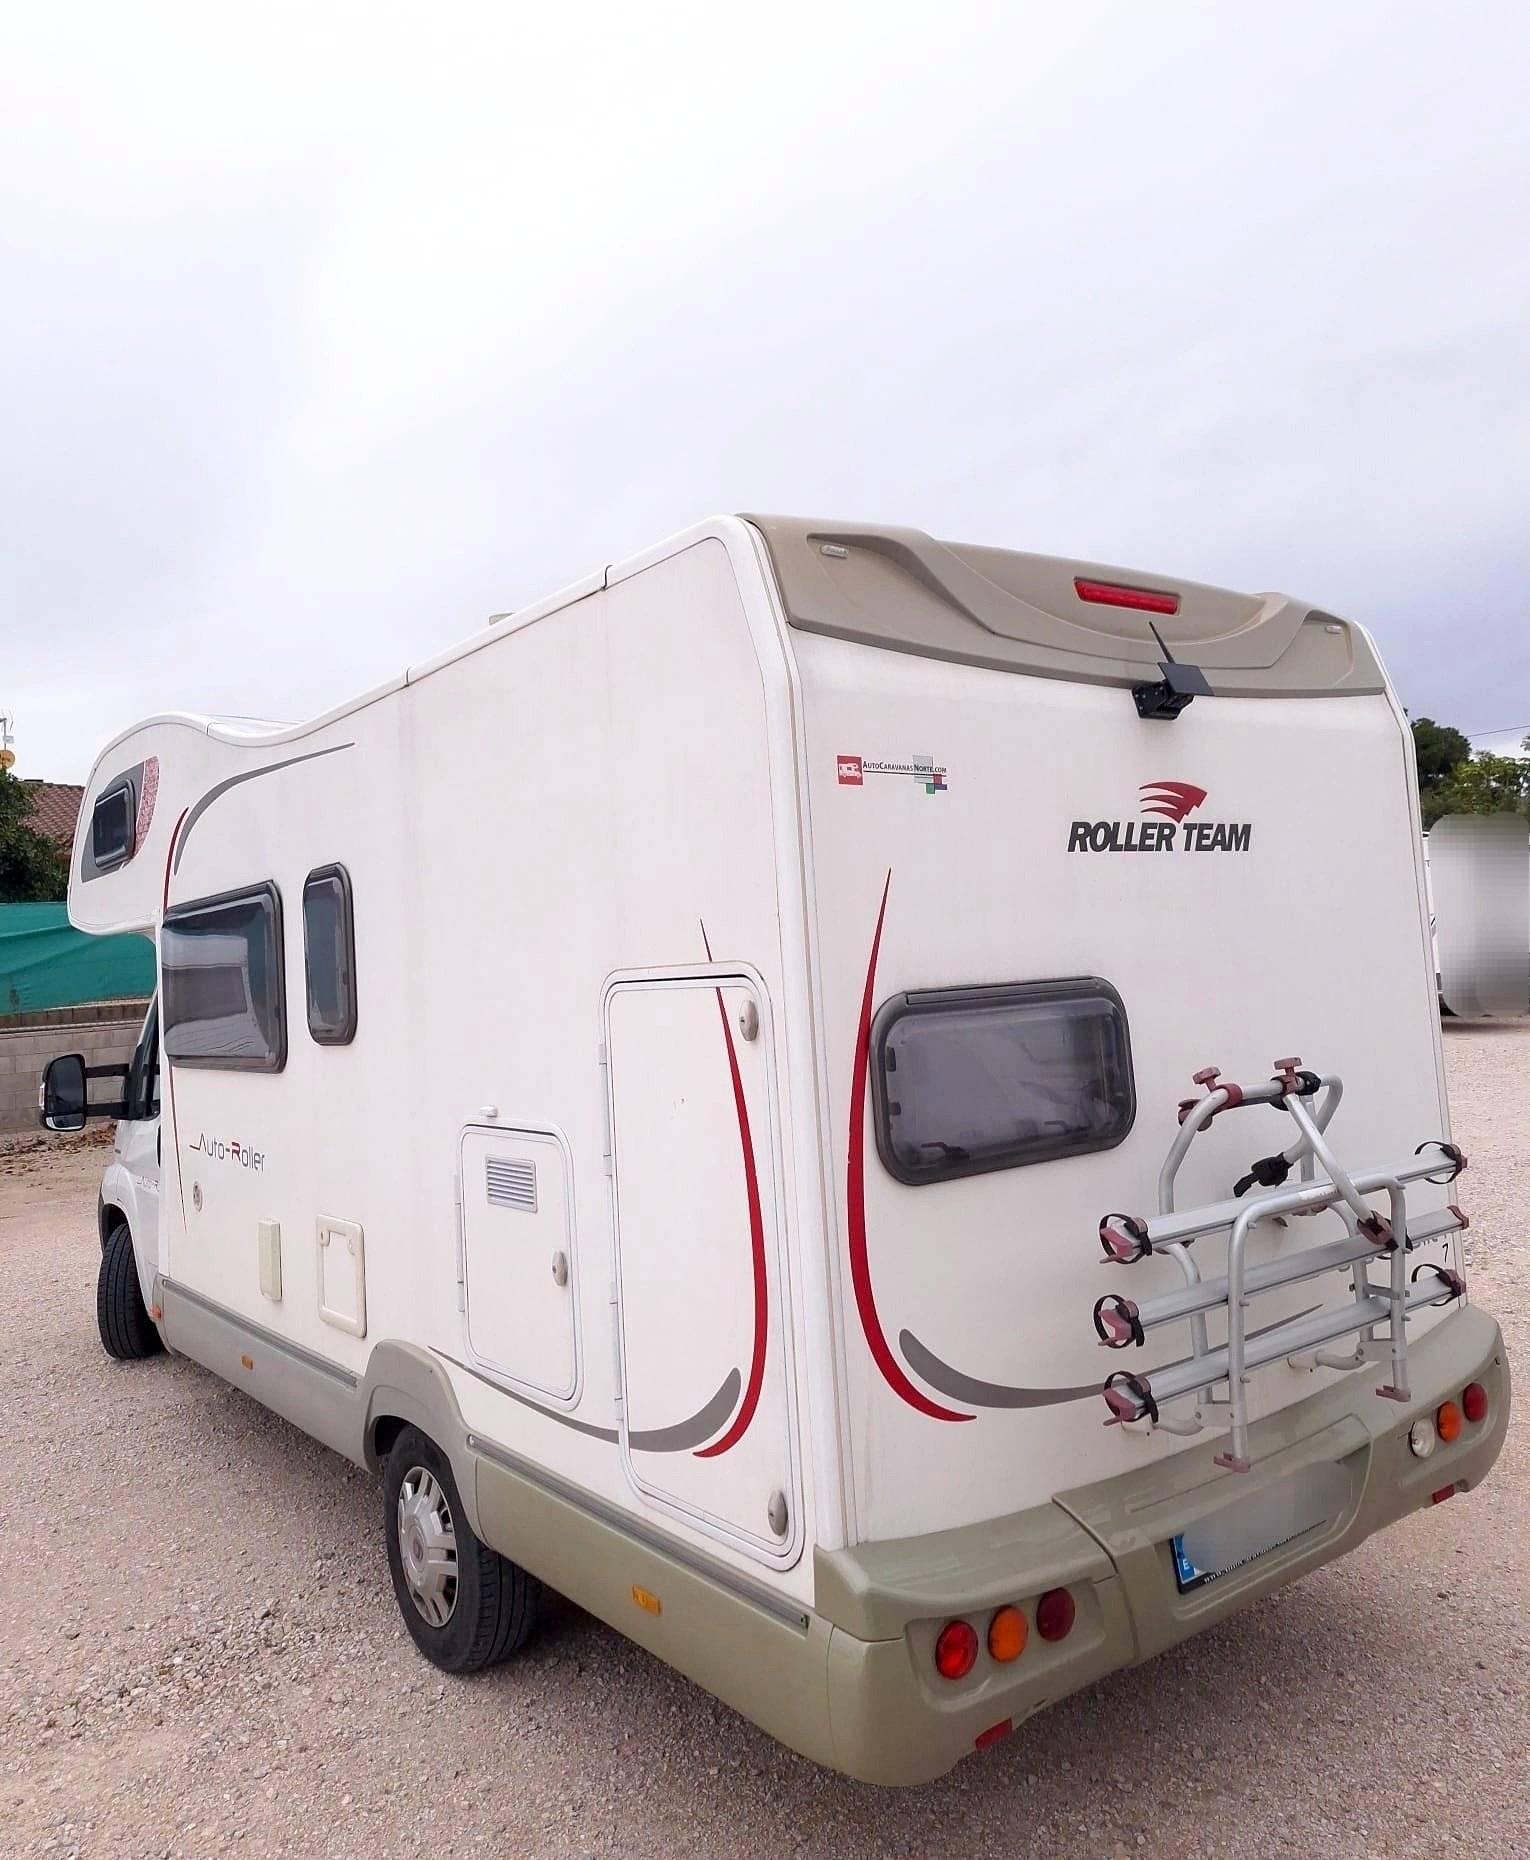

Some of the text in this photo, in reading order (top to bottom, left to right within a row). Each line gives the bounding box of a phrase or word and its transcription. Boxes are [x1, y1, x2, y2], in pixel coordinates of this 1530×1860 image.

[1067, 821, 1252, 852] ROLLER TEAM
[190, 1133, 265, 1173] Auto-Roller
[1183, 1560, 1189, 1570] E
